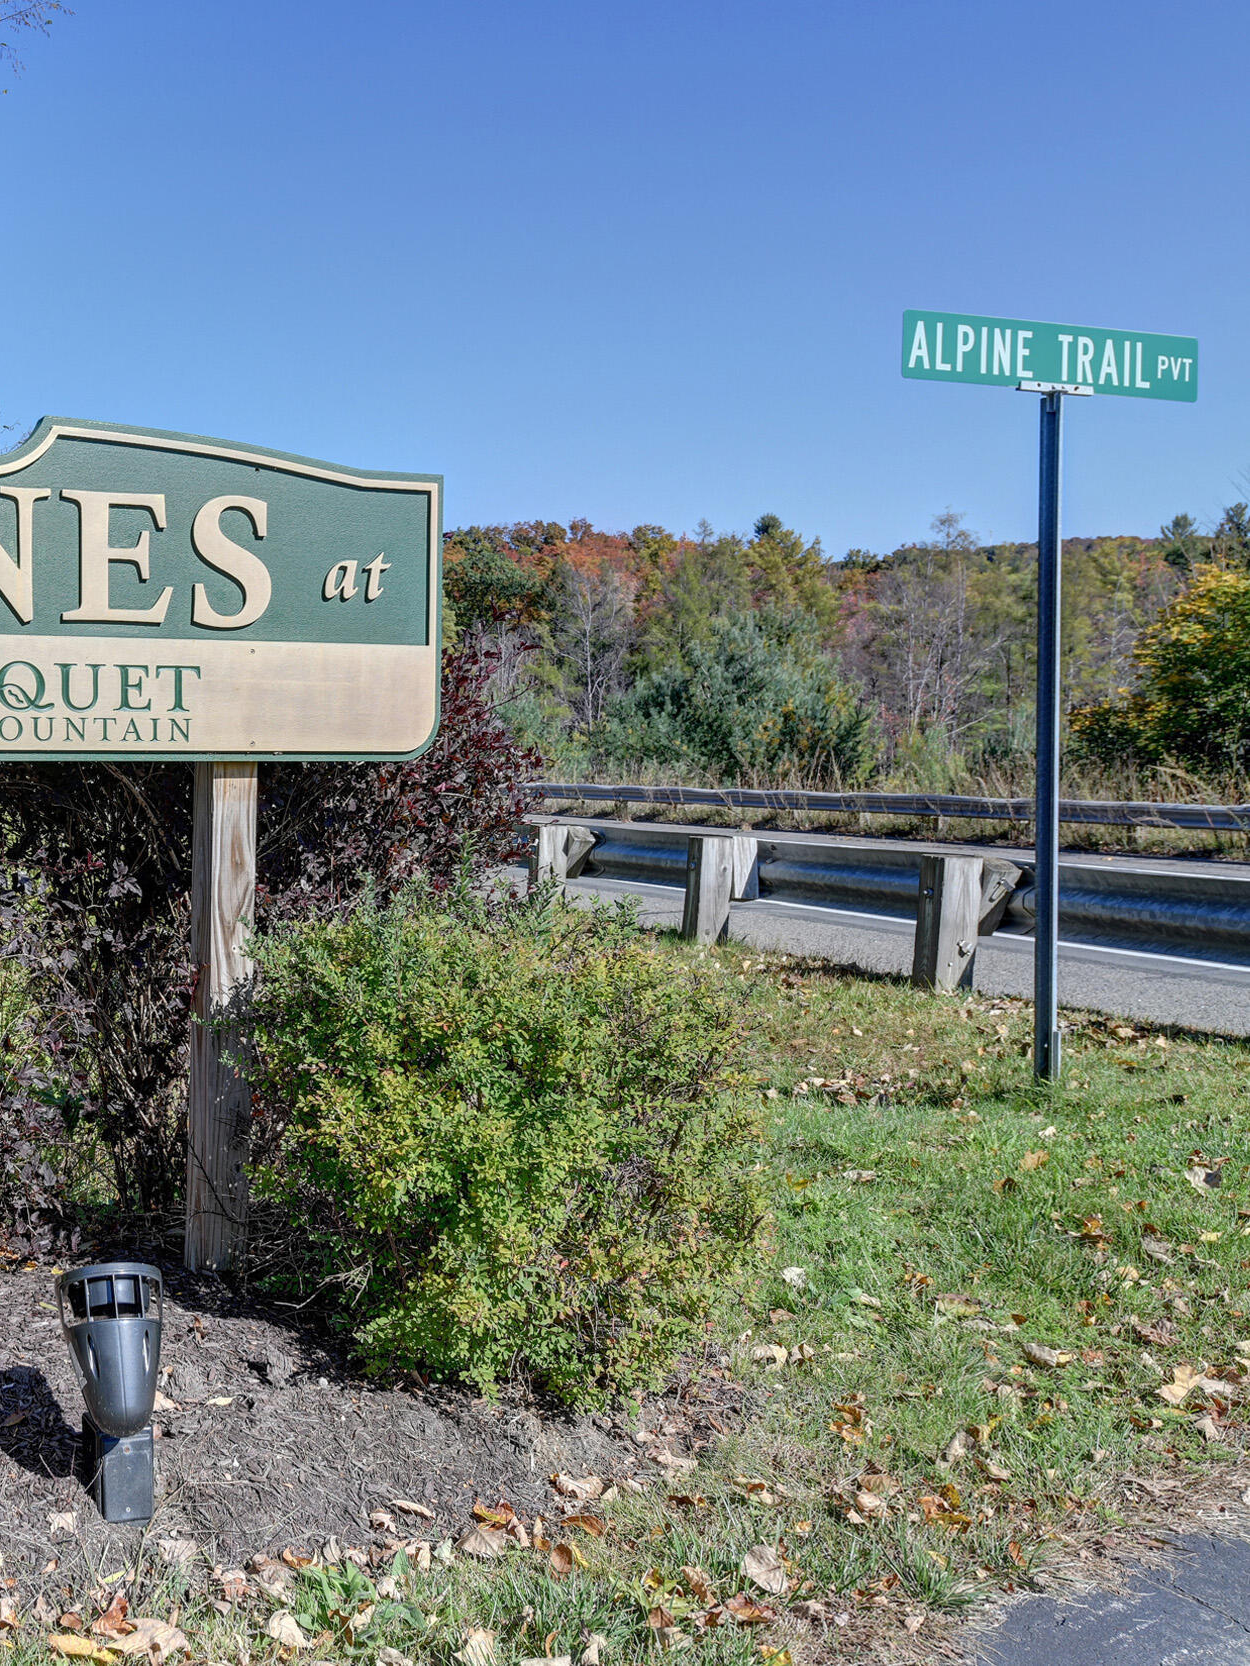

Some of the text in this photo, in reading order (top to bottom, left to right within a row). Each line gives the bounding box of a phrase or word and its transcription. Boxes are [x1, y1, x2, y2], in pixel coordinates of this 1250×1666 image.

[908, 320, 1193, 389] ALPINE TRAIL PVT
[323, 551, 392, 602] at
